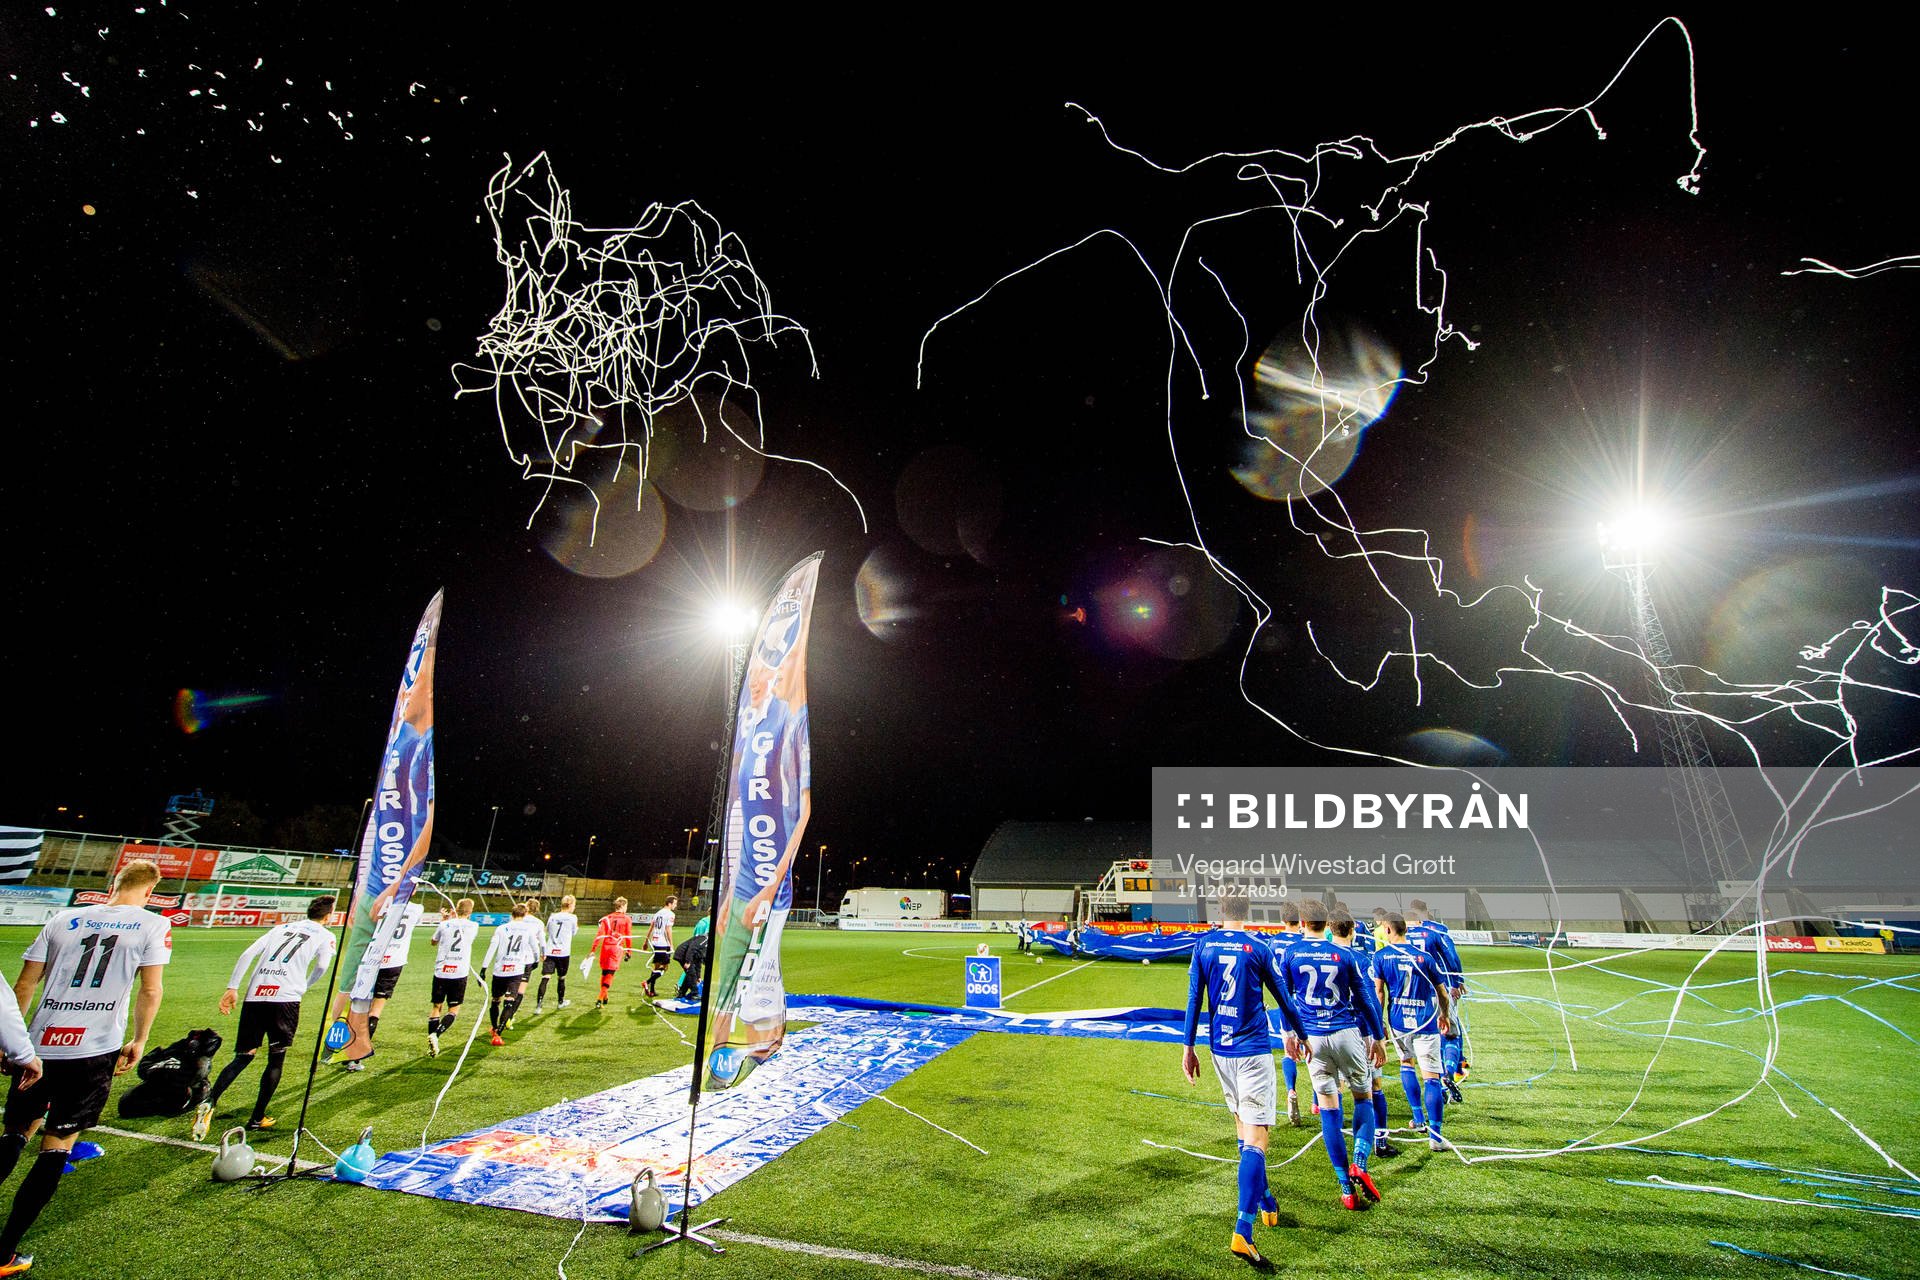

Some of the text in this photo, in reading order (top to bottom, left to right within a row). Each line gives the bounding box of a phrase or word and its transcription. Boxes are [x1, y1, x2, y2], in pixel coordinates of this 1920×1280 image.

[378, 822, 405, 885] OSS
[748, 814, 777, 886] OSS
[84, 919, 142, 931] Sognekraft
[556, 921, 563, 938] 7
[268, 931, 311, 964] 77
[450, 929, 462, 952] 2
[506, 934, 523, 955] 14
[1841, 939, 1873, 947] TicketCo
[70, 933, 120, 988] 11
[967, 983, 998, 995] OBOS
[1218, 955, 1237, 1001] 3
[1299, 964, 1340, 1007] 23
[1398, 964, 1413, 997] 7
[258, 988, 279, 997] MOT
[43, 999, 116, 1011] Ramsland
[48, 1032, 85, 1046] MOT
